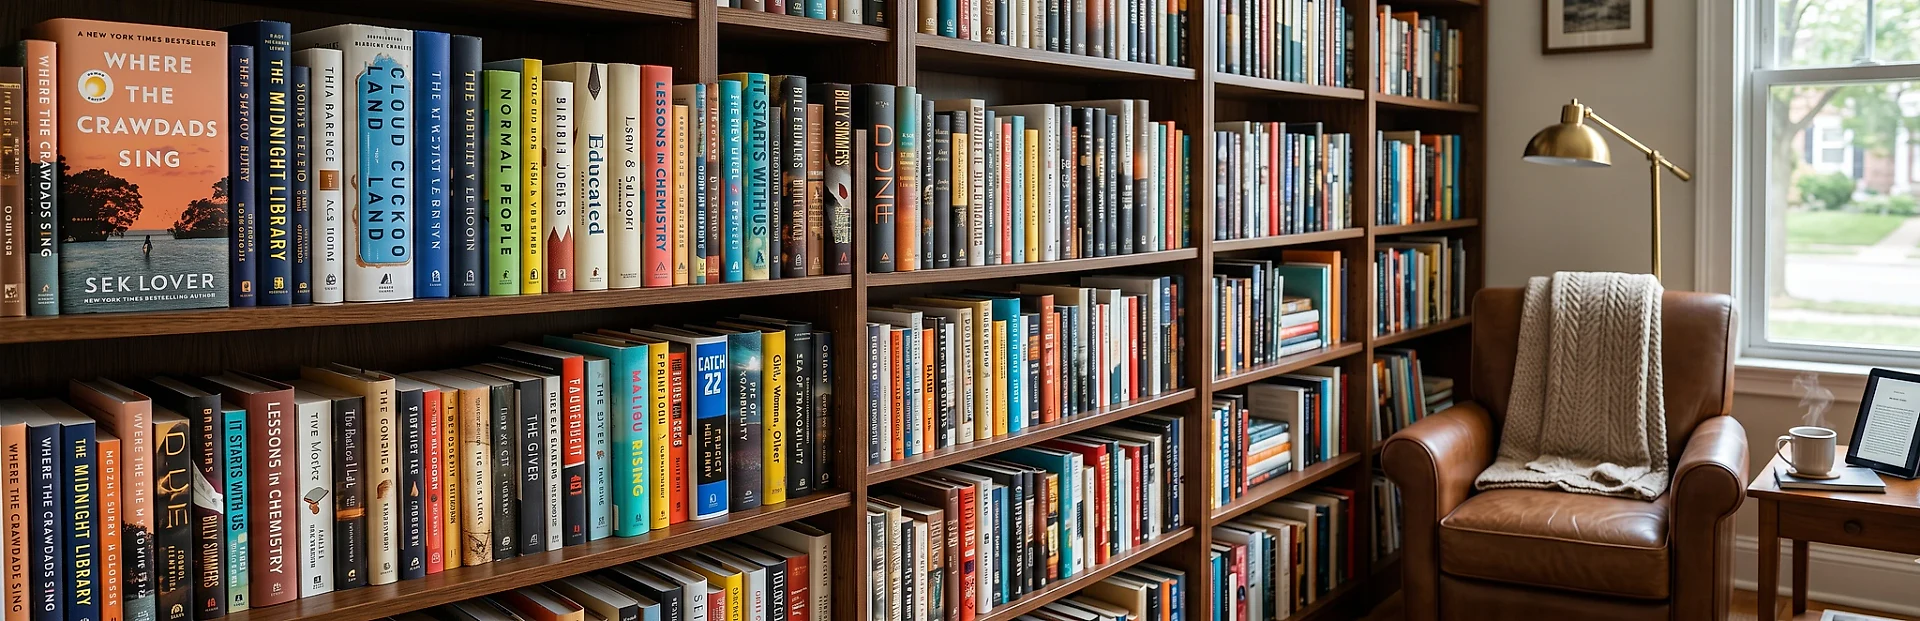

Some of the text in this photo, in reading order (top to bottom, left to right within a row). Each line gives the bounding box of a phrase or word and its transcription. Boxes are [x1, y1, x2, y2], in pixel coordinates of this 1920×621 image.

[165, 38, 216, 46] BESTSELLER
[104, 52, 192, 74] WHERE
[269, 59, 284, 85] THE
[125, 86, 173, 104] THE
[432, 70, 441, 100] THE
[466, 70, 475, 102] THE
[835, 90, 849, 117] BILLY
[77, 115, 217, 137] CRAWDADS
[269, 92, 286, 180] MIDNIGHT
[38, 55, 52, 258] WHERE THE CRAWDADS SING
[119, 151, 180, 167] SING
[367, 66, 383, 241] LAND LAND
[390, 67, 405, 257] CLOUD CUCKOO
[656, 82, 666, 251] LESSONS IN CHEMISTRY
[752, 80, 766, 236] IT STARTS WITH US
[500, 89, 511, 255] NORMAL PEOPLE
[589, 134, 604, 235] Educated
[270, 186, 286, 261] LIBRARY
[85, 274, 214, 293] SEK LOVER
[698, 354, 725, 372] CATCH
[596, 383, 604, 405] THE
[704, 372, 721, 395] 22
[796, 375, 803, 388] OF
[229, 420, 242, 431] IT
[267, 402, 281, 469] LESSONS
[230, 435, 243, 478] STARTS
[527, 414, 539, 482] THE GIVER
[9, 444, 18, 484] WHERE
[135, 457, 143, 477] THE
[632, 439, 643, 497] RISING
[10, 488, 19, 509] THE
[231, 481, 243, 512] WITH
[42, 437, 54, 612] WHERE THE CRAWDADS SING
[74, 439, 91, 606] THE MIDNIGHT LIBRARY
[232, 513, 244, 532] US
[268, 490, 283, 574] CHEMISTRY
[203, 515, 219, 588] BILLY SUMMERS
[12, 583, 22, 613] SING
